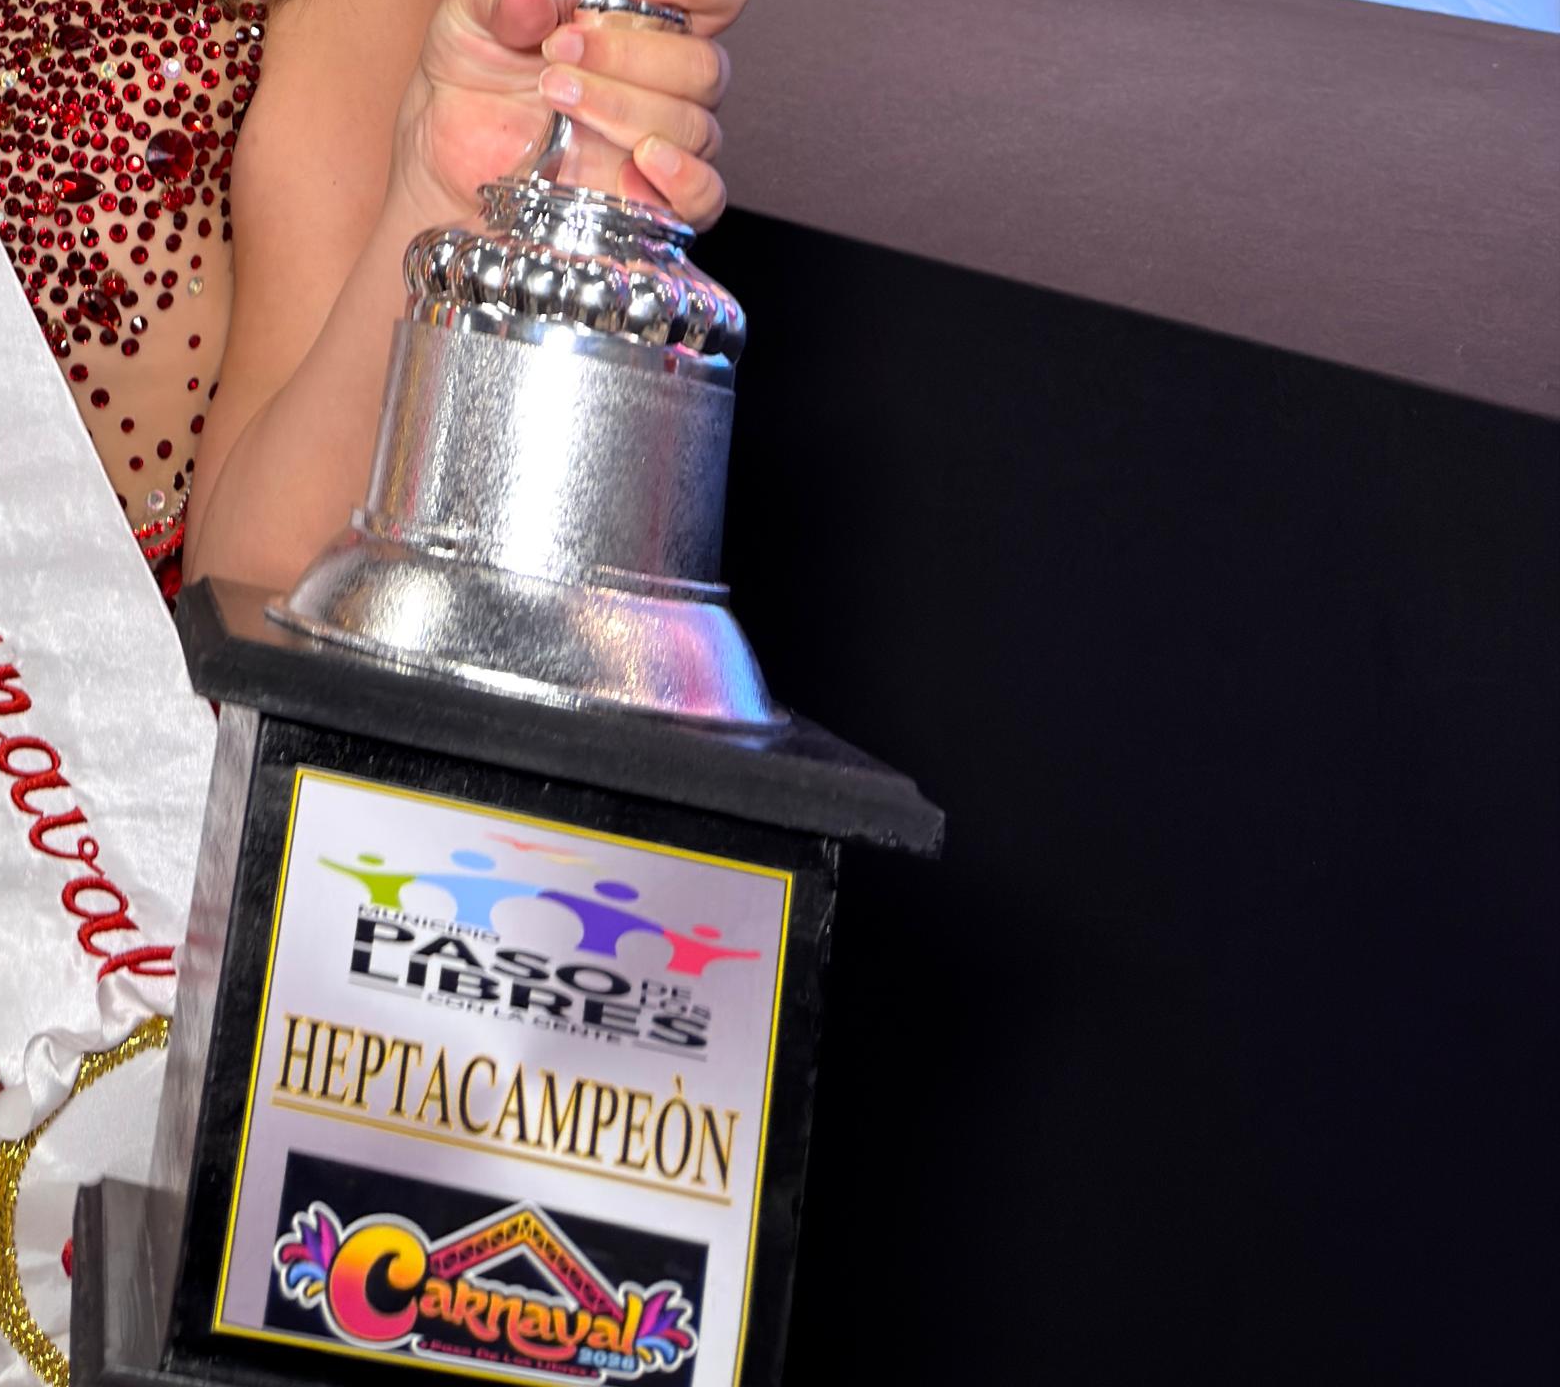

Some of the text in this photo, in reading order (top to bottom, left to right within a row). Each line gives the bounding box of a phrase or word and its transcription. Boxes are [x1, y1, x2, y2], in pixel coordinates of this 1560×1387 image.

[357, 904, 501, 943] MUNICIPIO
[352, 917, 631, 996] PASO
[349, 947, 708, 1047] LIBRES
[639, 995, 711, 1020] LOS
[641, 979, 692, 1000] DE
[427, 992, 622, 1044] CON LA GENTE
